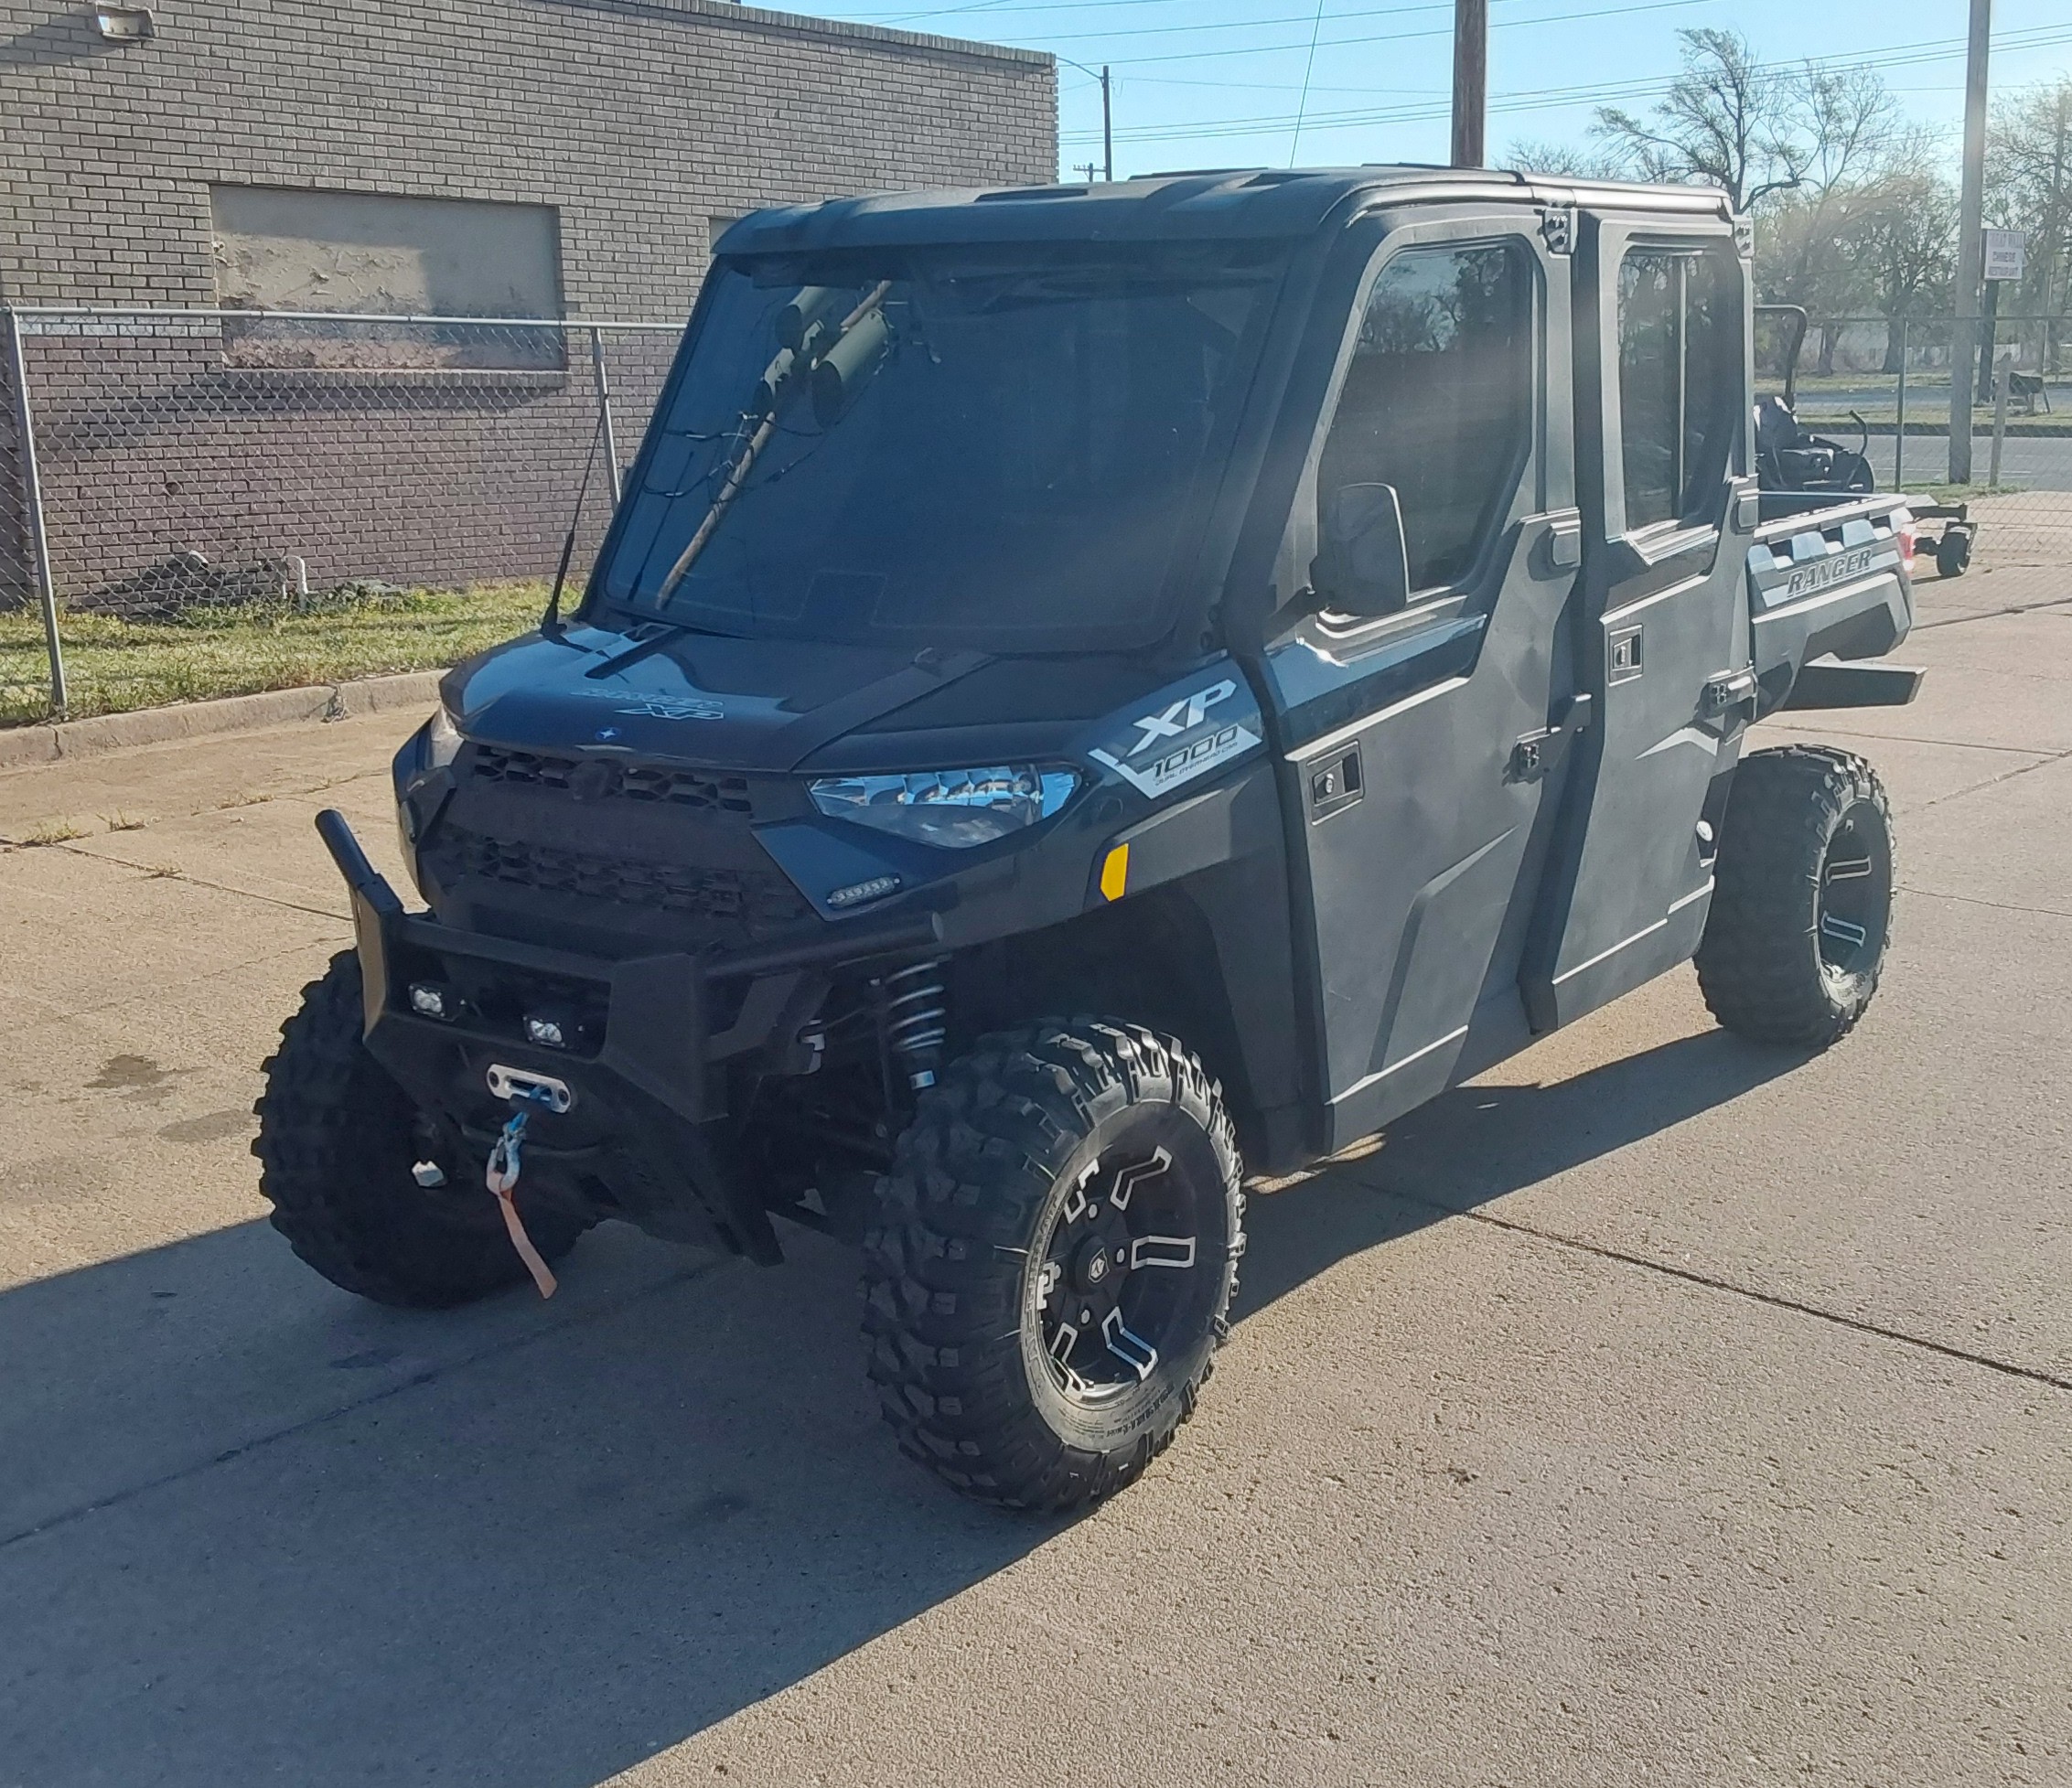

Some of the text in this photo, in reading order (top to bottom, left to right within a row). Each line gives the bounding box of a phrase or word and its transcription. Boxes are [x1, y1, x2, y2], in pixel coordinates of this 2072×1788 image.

[1787, 548, 1873, 597] RANGER
[614, 701, 725, 720] XP
[1126, 679, 1237, 757] XP
[1154, 724, 1239, 778] 1000
